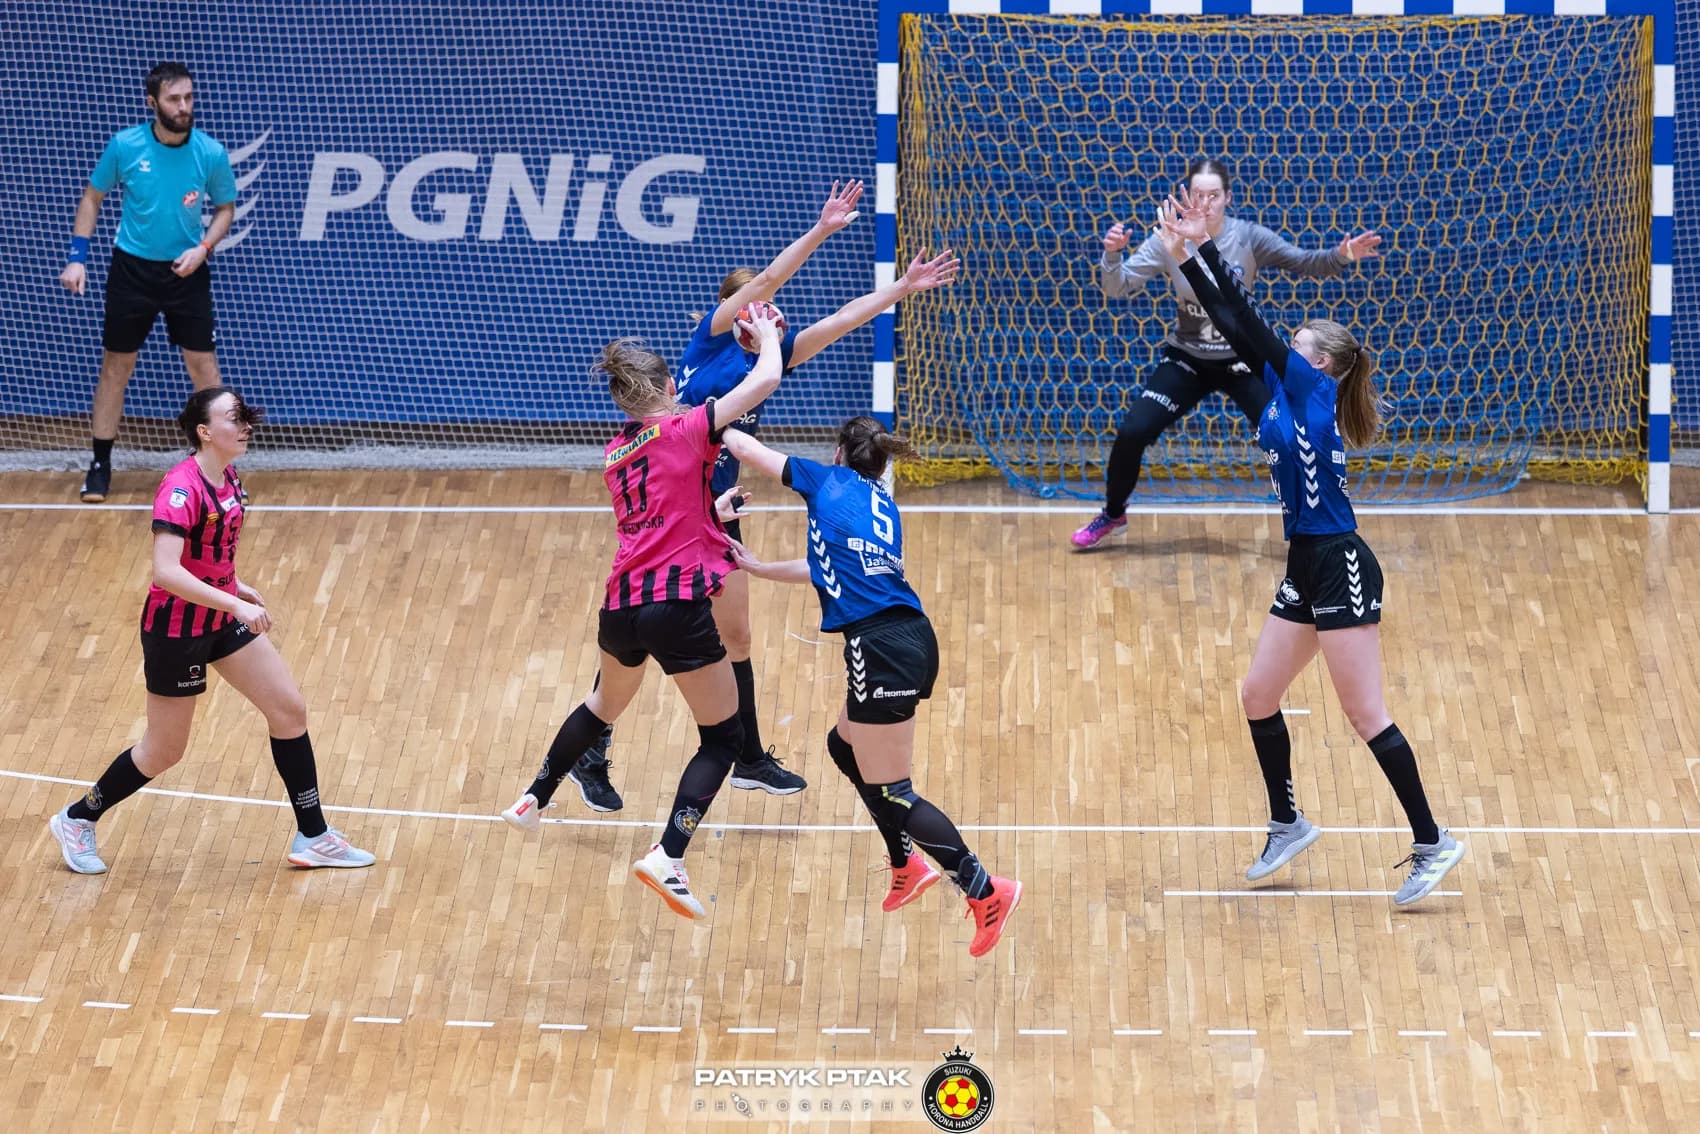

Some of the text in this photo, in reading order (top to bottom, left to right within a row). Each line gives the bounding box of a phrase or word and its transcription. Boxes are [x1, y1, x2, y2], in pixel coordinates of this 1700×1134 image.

[299, 151, 706, 244] PGNiG
[616, 455, 650, 515] 17
[871, 490, 893, 545] 5
